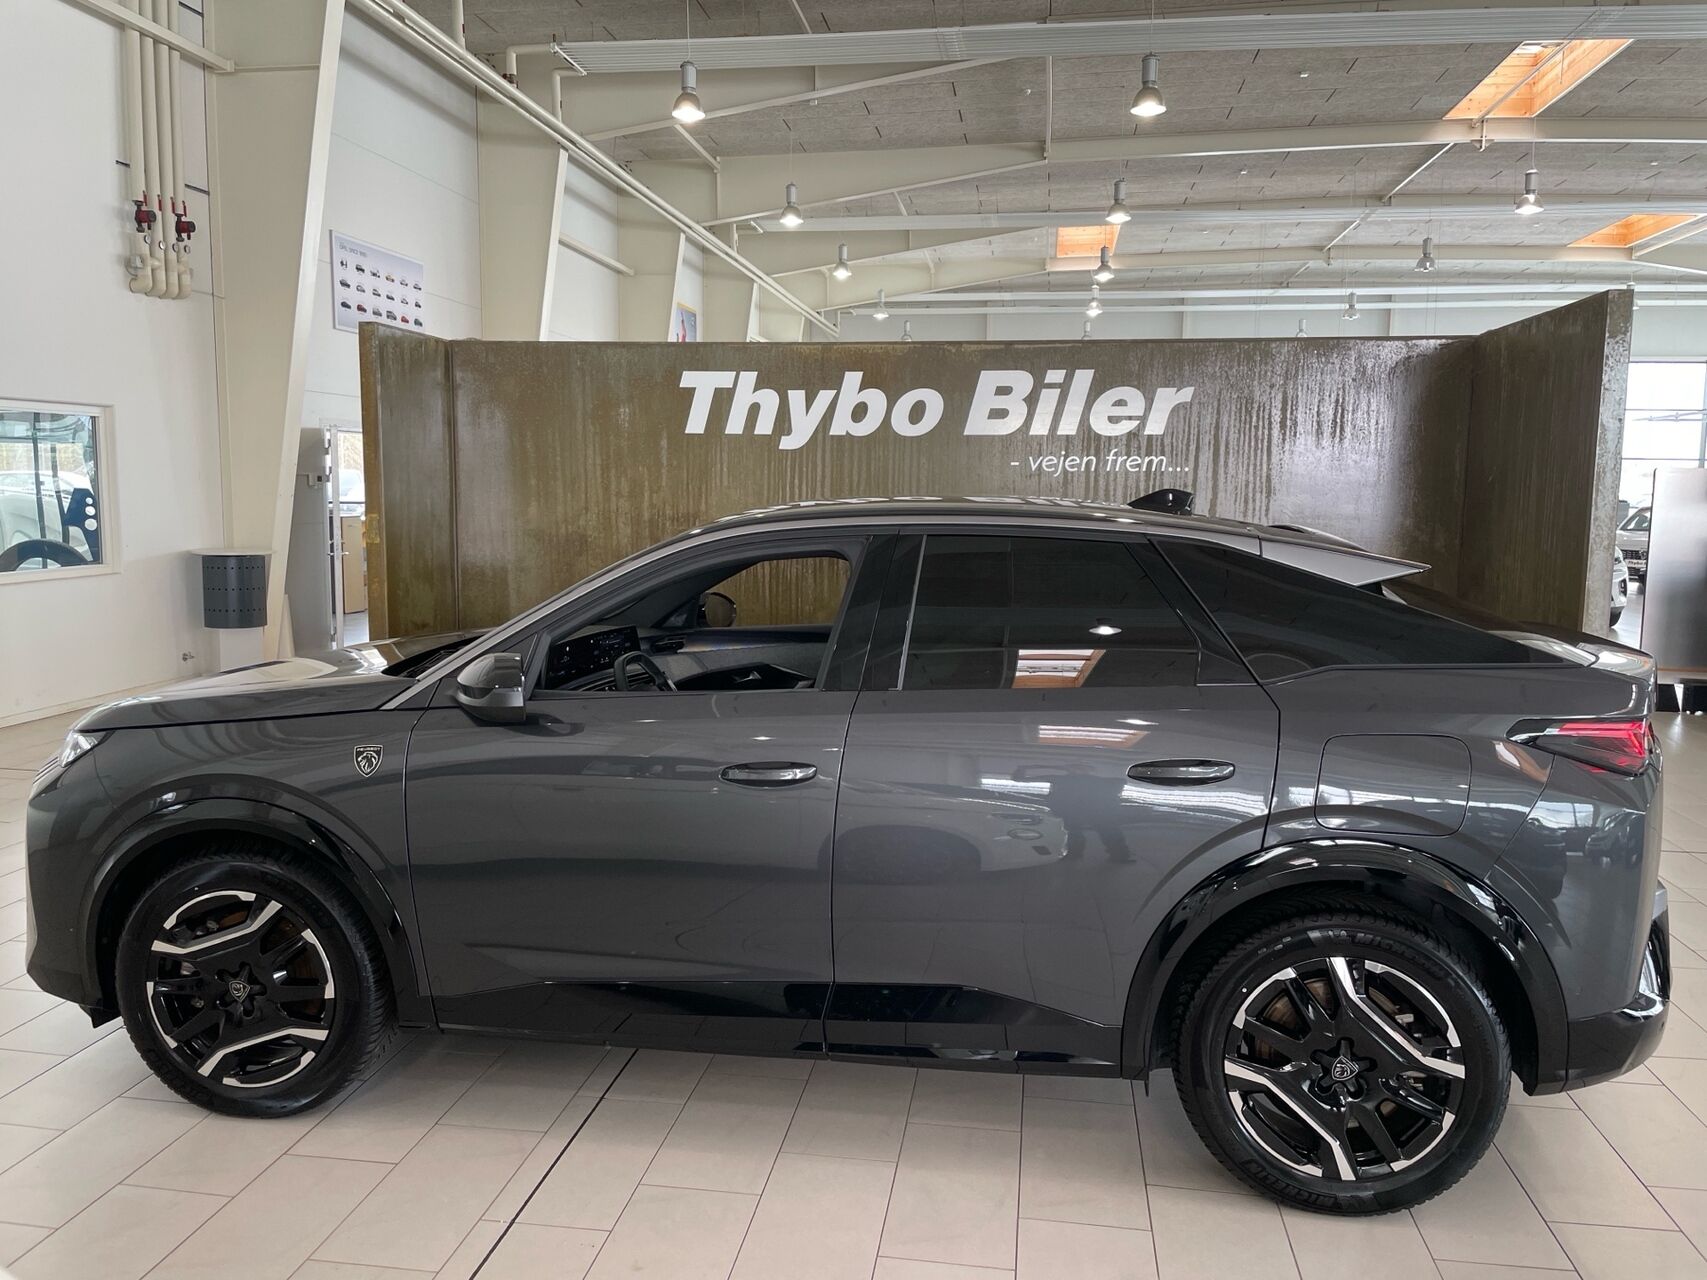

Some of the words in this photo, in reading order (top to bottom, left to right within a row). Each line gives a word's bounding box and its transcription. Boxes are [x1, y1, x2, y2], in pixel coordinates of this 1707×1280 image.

[679, 371, 944, 450] Thybo
[963, 369, 1195, 437] Biler
[1028, 450, 1097, 477] vejen
[1105, 448, 1190, 473] frem...
